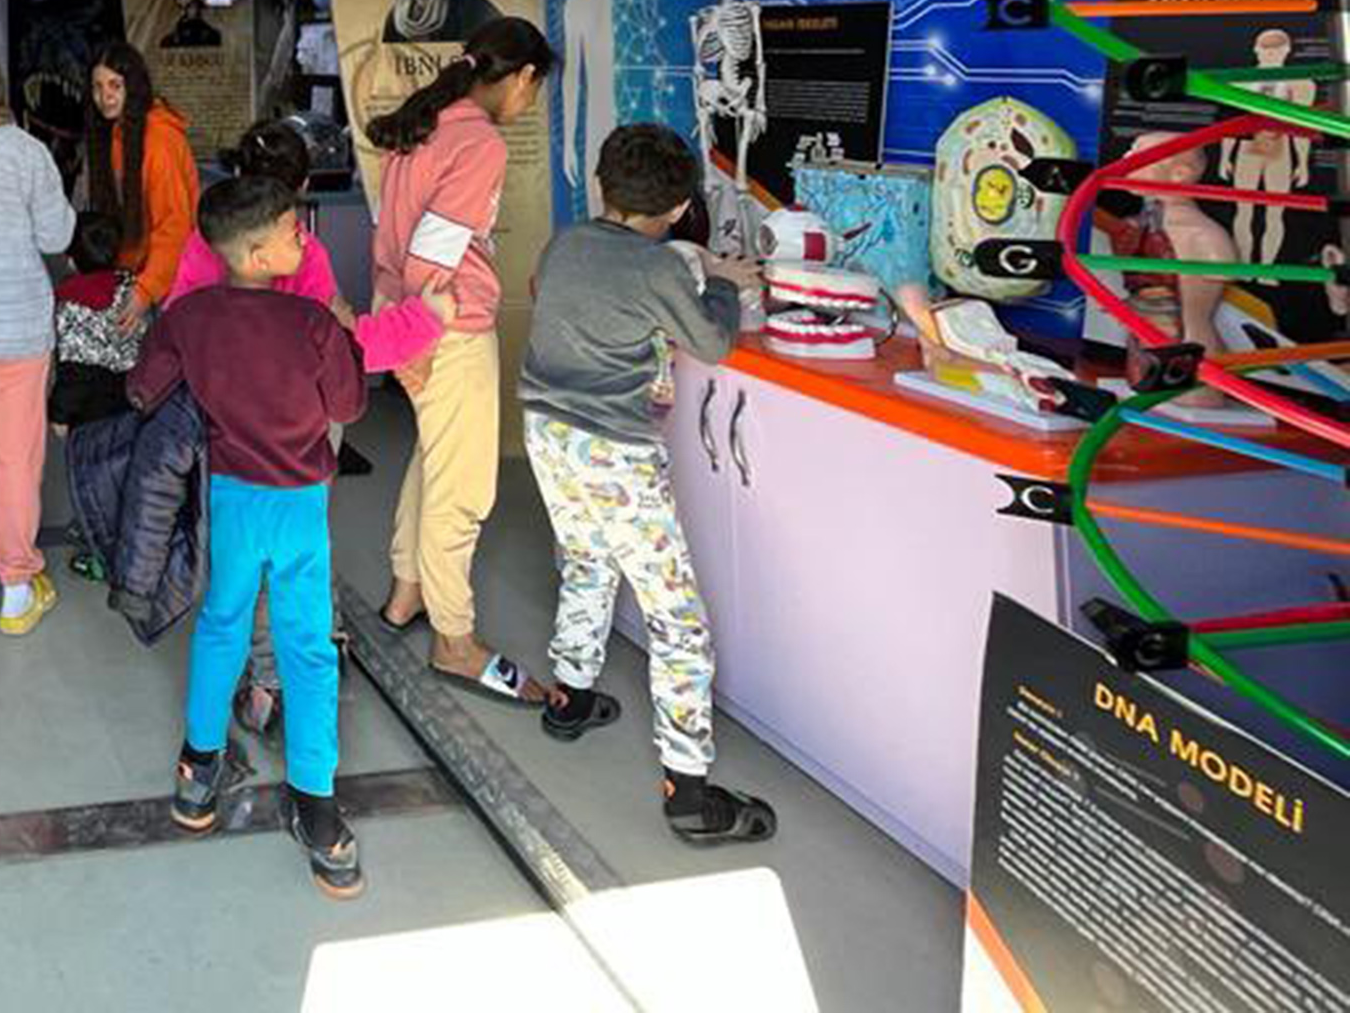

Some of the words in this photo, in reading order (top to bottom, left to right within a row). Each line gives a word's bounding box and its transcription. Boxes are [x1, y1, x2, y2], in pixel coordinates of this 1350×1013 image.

[999, 245, 1038, 274] G
[1020, 485, 1055, 514] C
[1095, 683, 1159, 742] DNA
[1170, 730, 1304, 833] MODELİ
